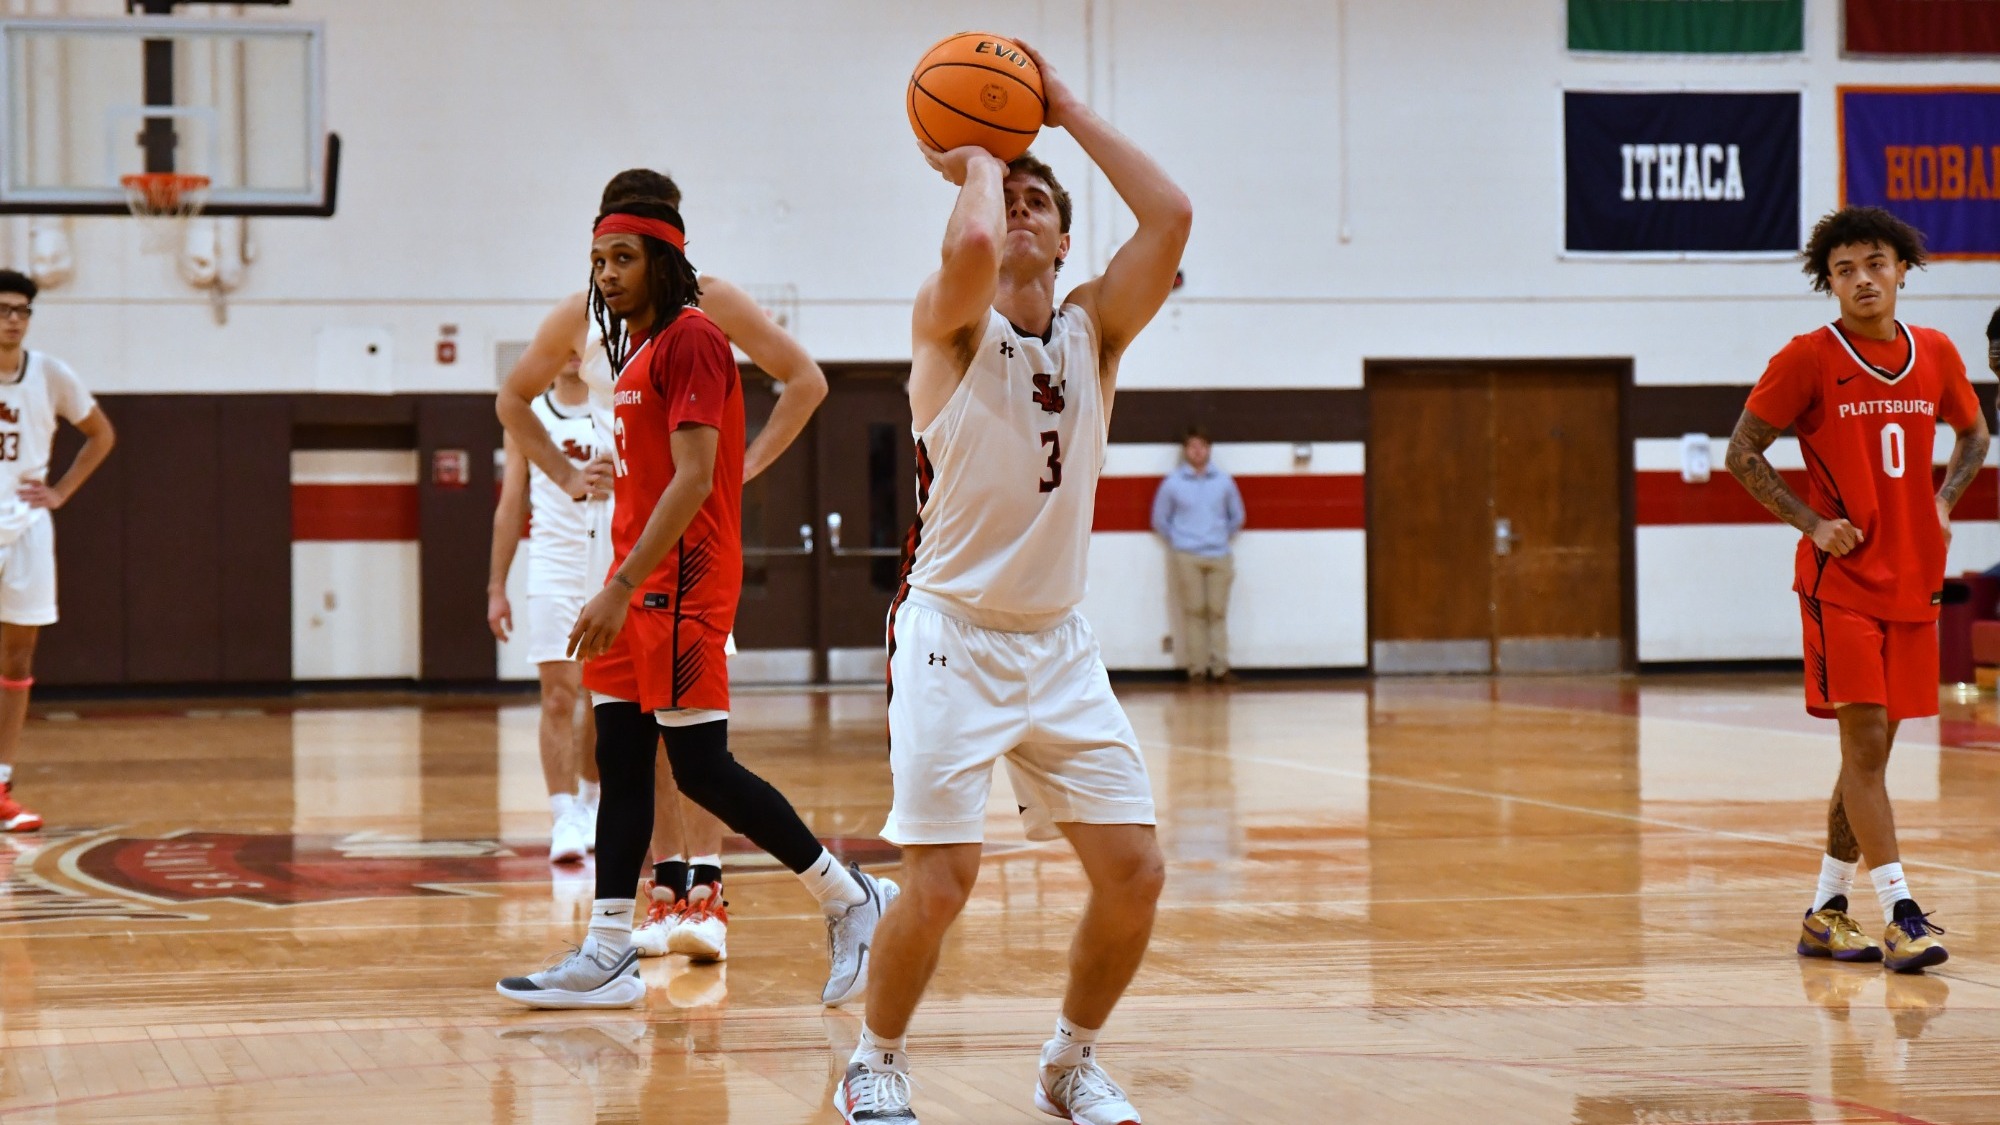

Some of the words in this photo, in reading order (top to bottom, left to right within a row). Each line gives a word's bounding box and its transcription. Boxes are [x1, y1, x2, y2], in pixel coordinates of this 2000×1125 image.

[975, 41, 1026, 68] EVO
[1621, 144, 1745, 200] ITHACA
[1839, 399, 1934, 418] PLATTSBURGH
[1039, 430, 1062, 493] 3
[1880, 423, 1905, 478] 0
